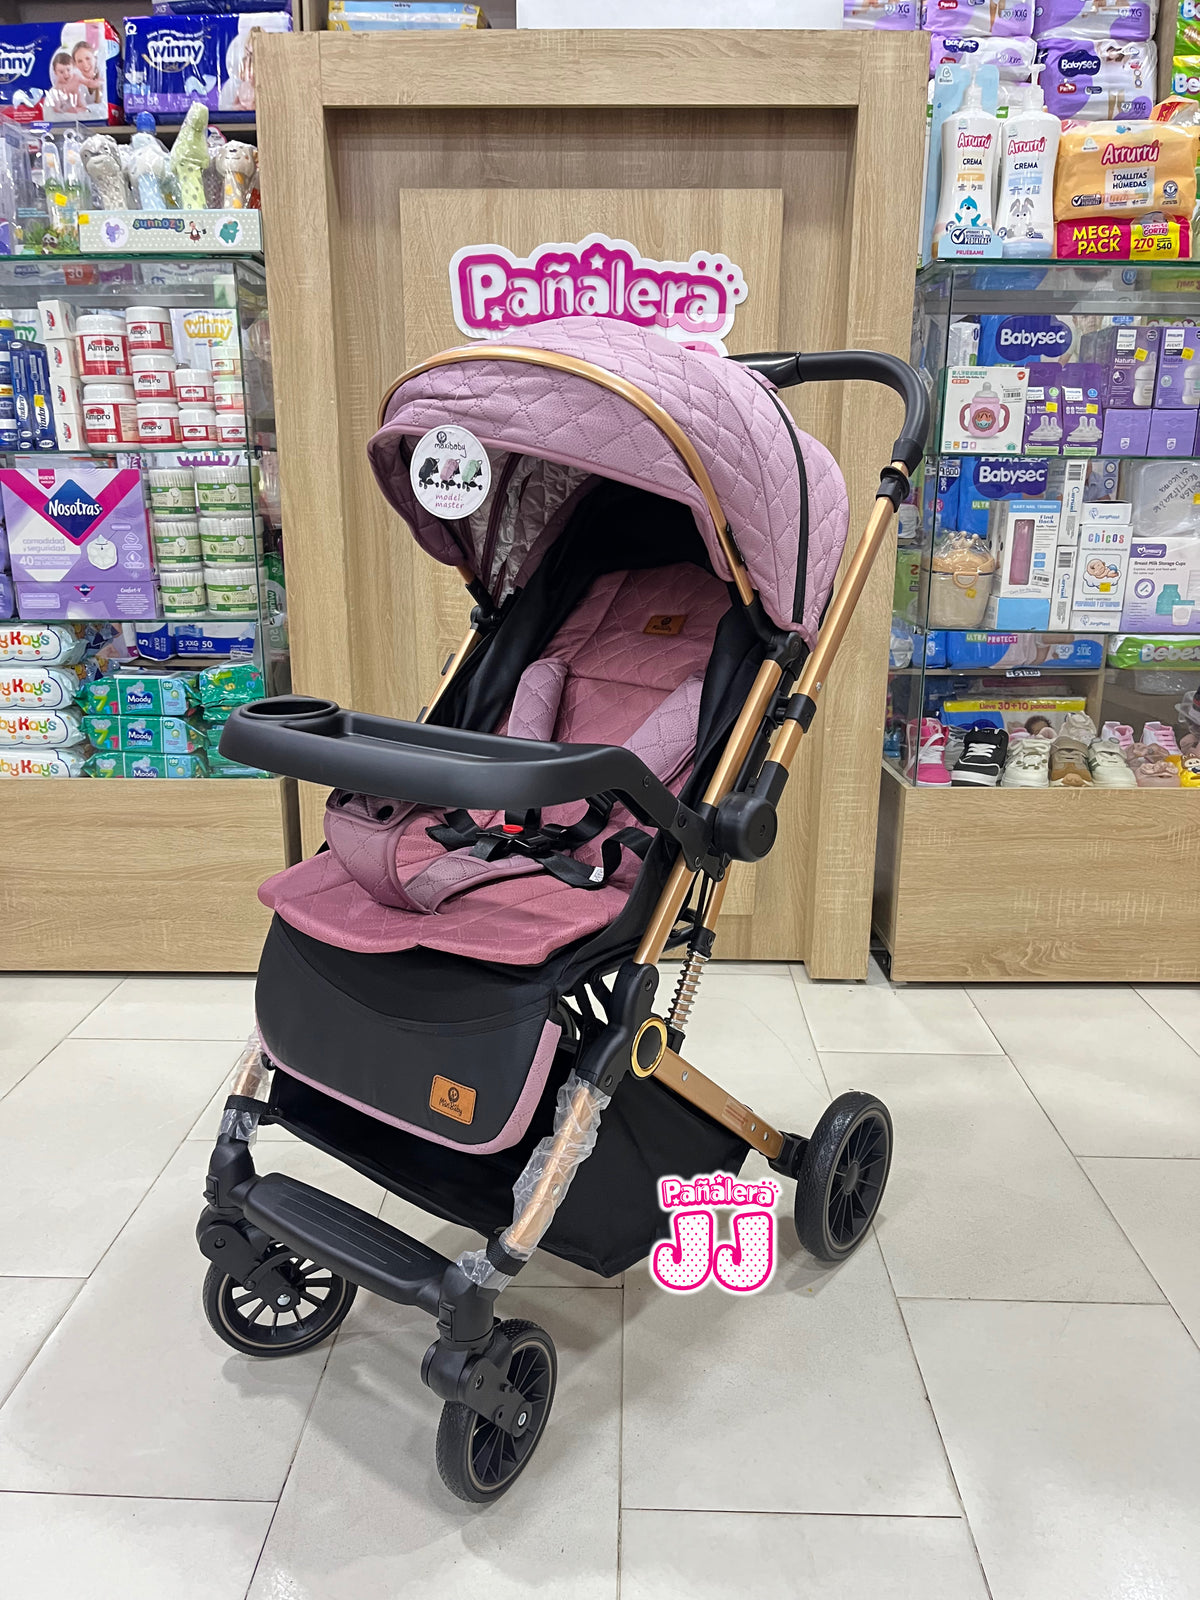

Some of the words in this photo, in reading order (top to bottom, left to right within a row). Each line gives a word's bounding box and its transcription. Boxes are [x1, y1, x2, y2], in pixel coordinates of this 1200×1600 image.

[898, 4, 910, 14] XG
[1014, 9, 1028, 18] XXG
[1130, 8, 1142, 17] XG
[150, 40, 203, 64] winny
[1061, 59, 1098, 71] Babysec
[1133, 102, 1146, 111] XXG
[1102, 141, 1159, 164] Arrurrú
[962, 158, 983, 167] CREMA
[1112, 172, 1148, 181] TOALLITAS
[1112, 180, 1147, 189] HÚMEDAS
[133, 218, 185, 232] sunnozy
[1073, 225, 1122, 241] MEGA
[1078, 237, 1121, 255] PACK
[1134, 238, 1155, 250] 270
[1157, 242, 1172, 250] 540
[464, 254, 722, 322] Pañalera
[188, 316, 231, 338] winny
[1001, 329, 1067, 347] Babysec
[979, 466, 1047, 485] Babysec
[48, 498, 101, 517] Nosotras
[1088, 530, 1125, 544] chicos
[10, 631, 50, 649] Kay's
[201, 640, 213, 648] 50
[966, 633, 987, 641] ULTRA
[987, 635, 1018, 643] PROTECT
[12, 678, 52, 696] Kay's
[127, 694, 152, 704] Moody
[18, 716, 57, 734] Kay's
[128, 731, 152, 741] Moody
[21, 759, 60, 778] Kay's
[133, 769, 158, 778] Moody
